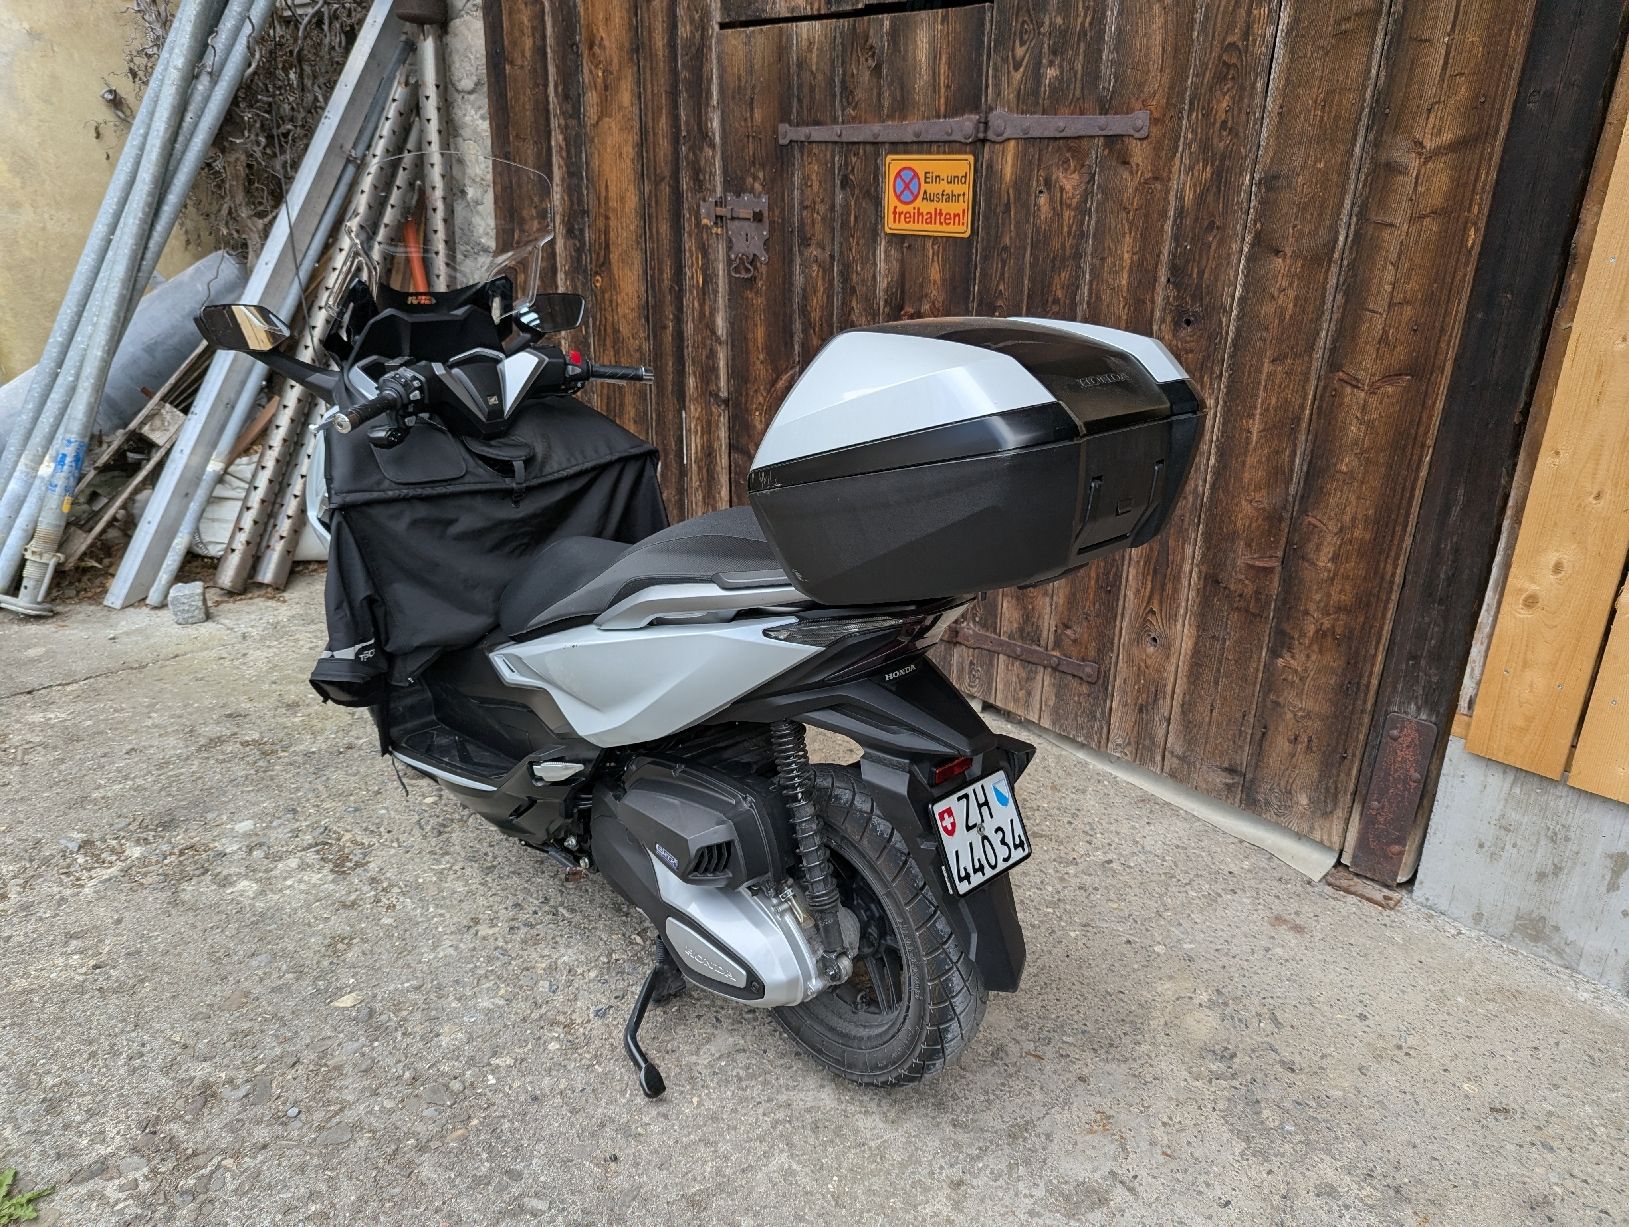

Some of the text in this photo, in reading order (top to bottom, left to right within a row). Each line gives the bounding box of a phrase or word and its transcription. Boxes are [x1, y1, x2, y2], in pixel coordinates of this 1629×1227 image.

[921, 189, 966, 204] Ausfahrt
[892, 205, 966, 227] freihalten!
[884, 664, 917, 681] HONDA
[956, 783, 994, 833] ZH
[954, 818, 1026, 886] 44034
